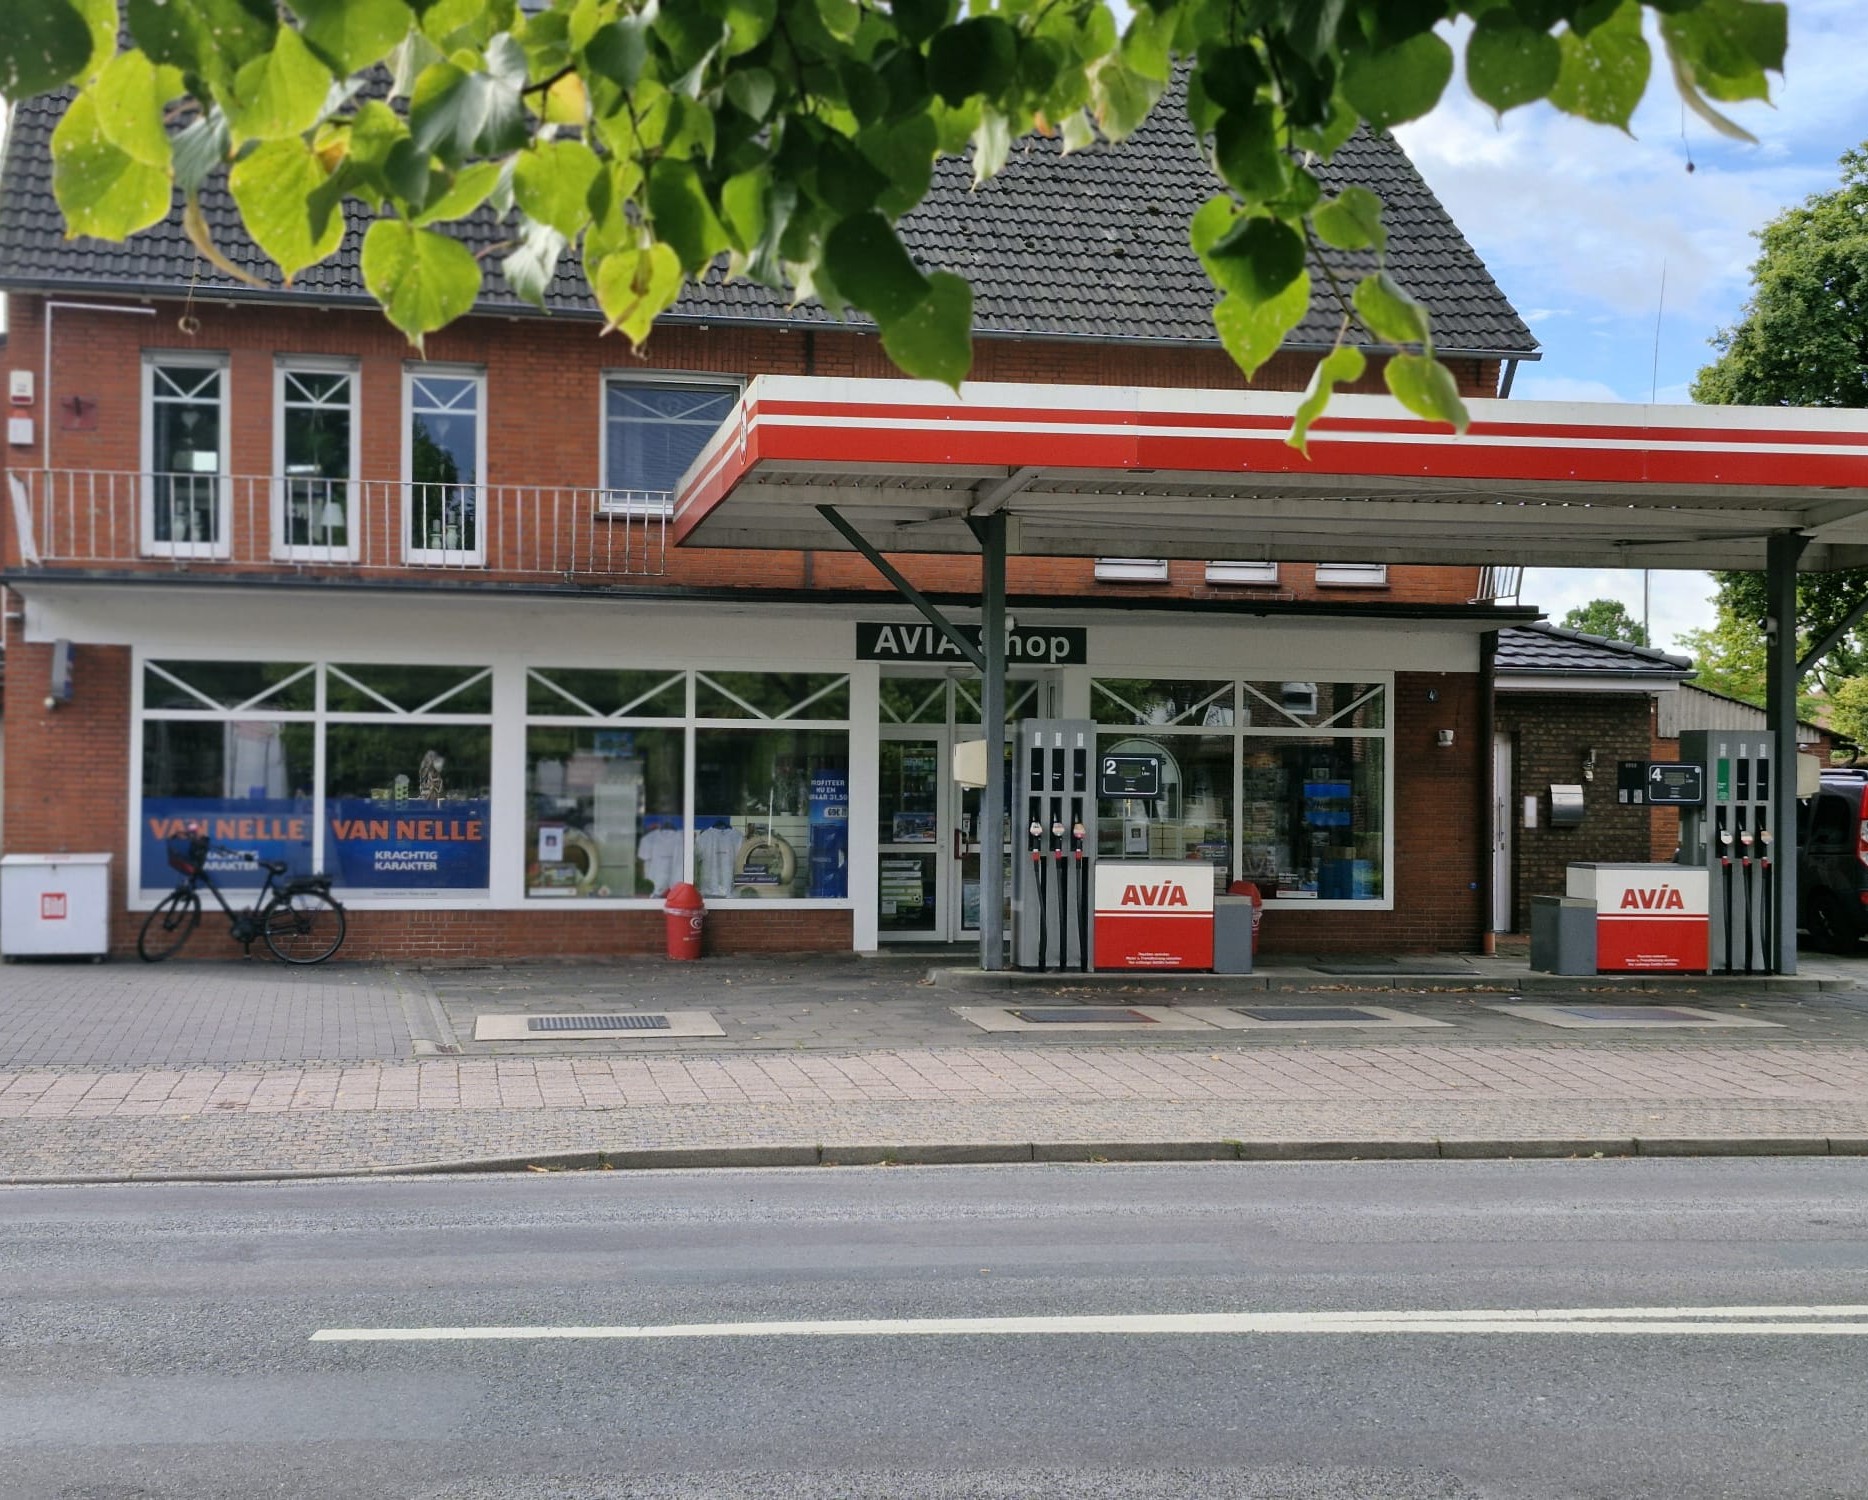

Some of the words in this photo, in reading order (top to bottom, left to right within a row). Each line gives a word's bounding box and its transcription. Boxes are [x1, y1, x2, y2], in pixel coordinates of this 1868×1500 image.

[873, 626, 962, 655] AVIA
[978, 631, 1070, 663] hop
[1106, 760, 1117, 775] 2
[1651, 767, 1662, 781] 4
[215, 819, 304, 840] NELLE
[332, 820, 389, 840] VAN
[396, 820, 482, 840] NELLE
[375, 851, 437, 860] KRACHTIG
[202, 862, 259, 871] ARAKTER
[375, 862, 437, 871] KARAKTER
